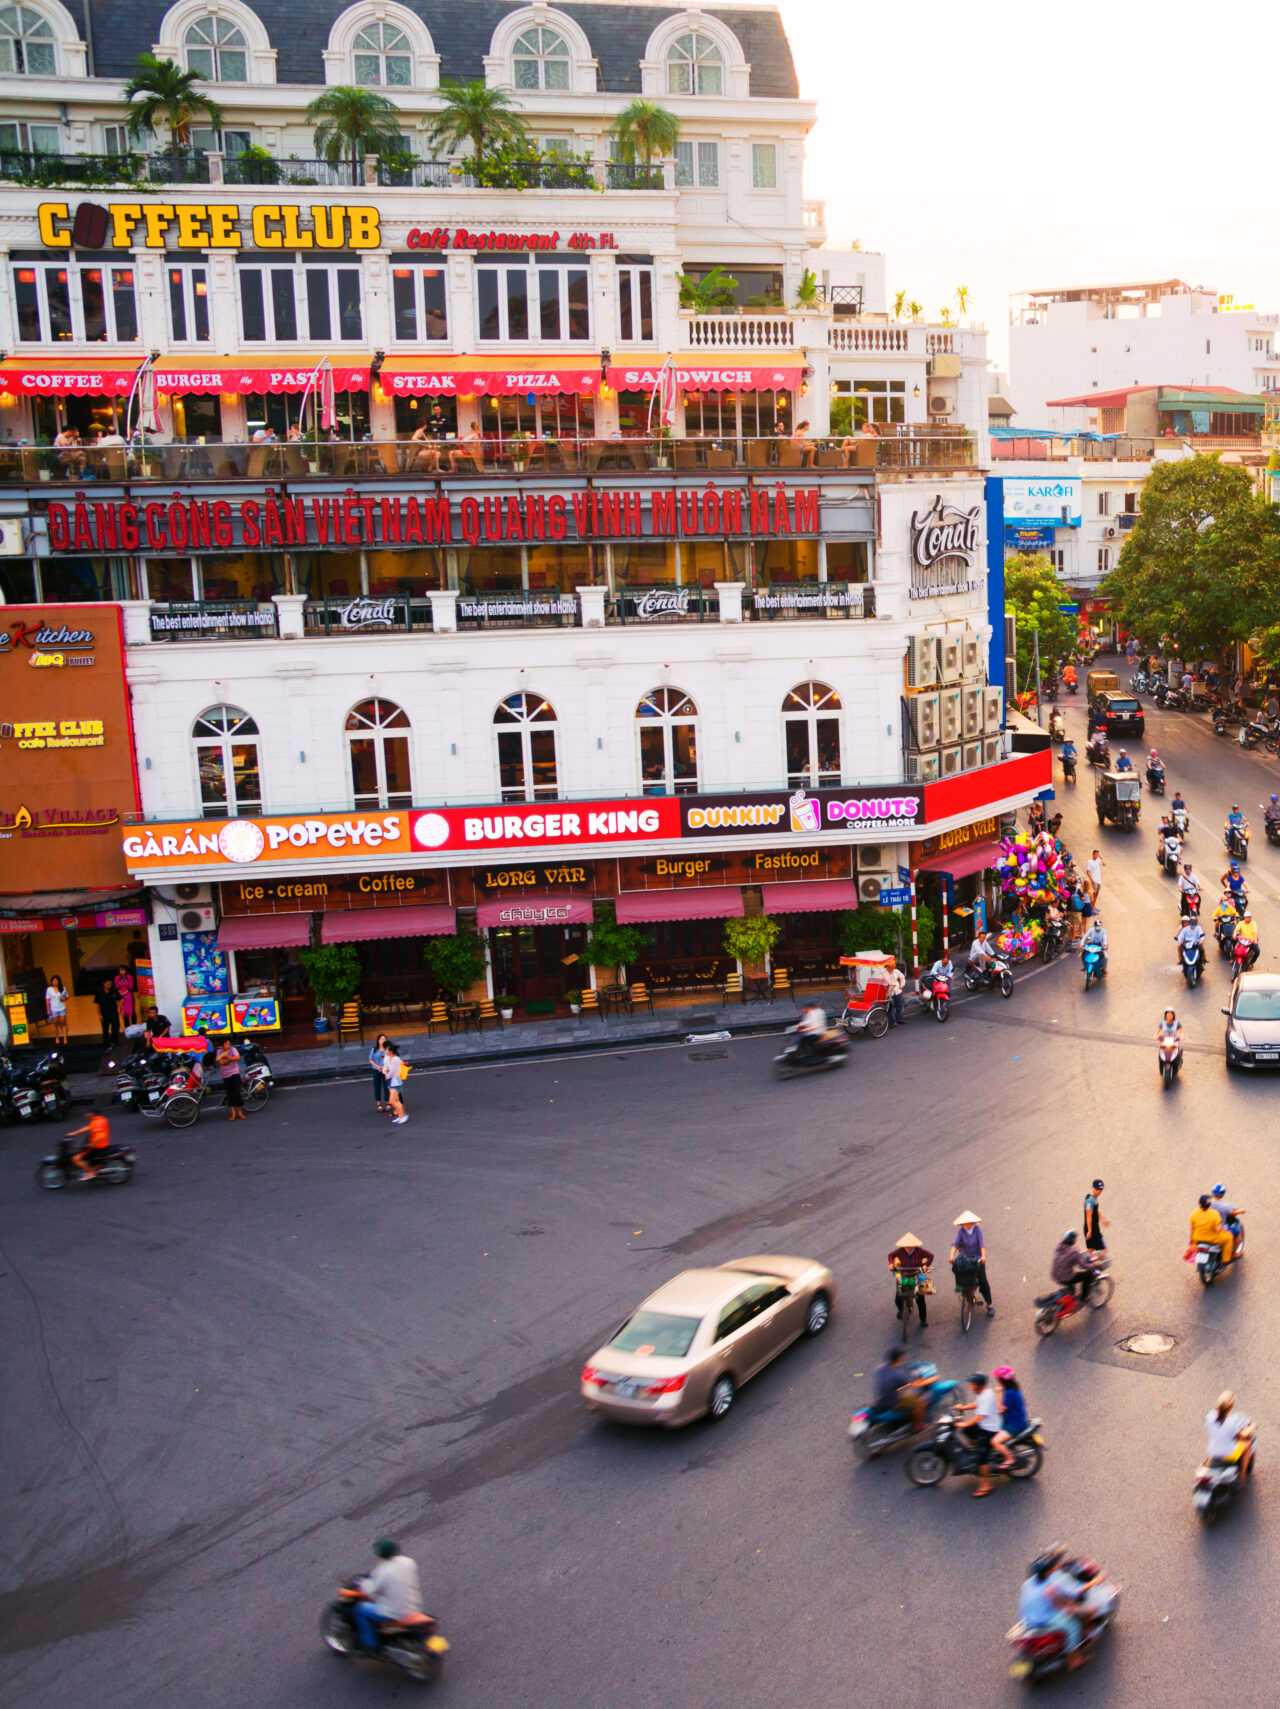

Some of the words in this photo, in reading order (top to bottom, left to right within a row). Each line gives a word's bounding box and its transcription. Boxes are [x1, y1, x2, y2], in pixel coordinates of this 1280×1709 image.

[251, 205, 381, 249] CLUB
[406, 227, 450, 249] Café
[453, 228, 560, 250] Restaurant
[567, 232, 596, 249] 4th
[21, 374, 104, 388] COFFEE
[156, 373, 224, 387] BURGER
[270, 373, 323, 386] PAST
[393, 375, 456, 389] STEAK
[506, 374, 561, 388] PIZZA
[624, 370, 753, 384] SADWICH
[47, 491, 140, 550] ĐẢNG
[240, 487, 307, 546] SẢN
[381, 496, 452, 544] NAM
[461, 494, 566, 547] QUANG
[571, 491, 642, 537] VINH
[652, 481, 742, 536] MUÔN
[751, 481, 820, 535] NĂM
[460, 602, 472, 617] The
[473, 602, 488, 616] best
[754, 594, 765, 609] The
[765, 593, 780, 609] best
[152, 615, 165, 630] The
[165, 614, 181, 629] best
[181, 613, 228, 629] entertainment
[229, 613, 246, 627] show
[255, 612, 275, 626] Hanoi
[10, 621, 93, 648] Kitchen
[60, 720, 104, 736] CLUB
[43, 807, 117, 824] VILLAGE
[827, 796, 919, 821] DONUTS
[464, 813, 582, 841] BURGER
[588, 809, 660, 835] KING
[655, 858, 711, 877] Burger
[755, 850, 820, 869] Fastfood
[240, 882, 265, 900] Ice
[277, 882, 328, 898] cream
[358, 876, 416, 893] Coffee
